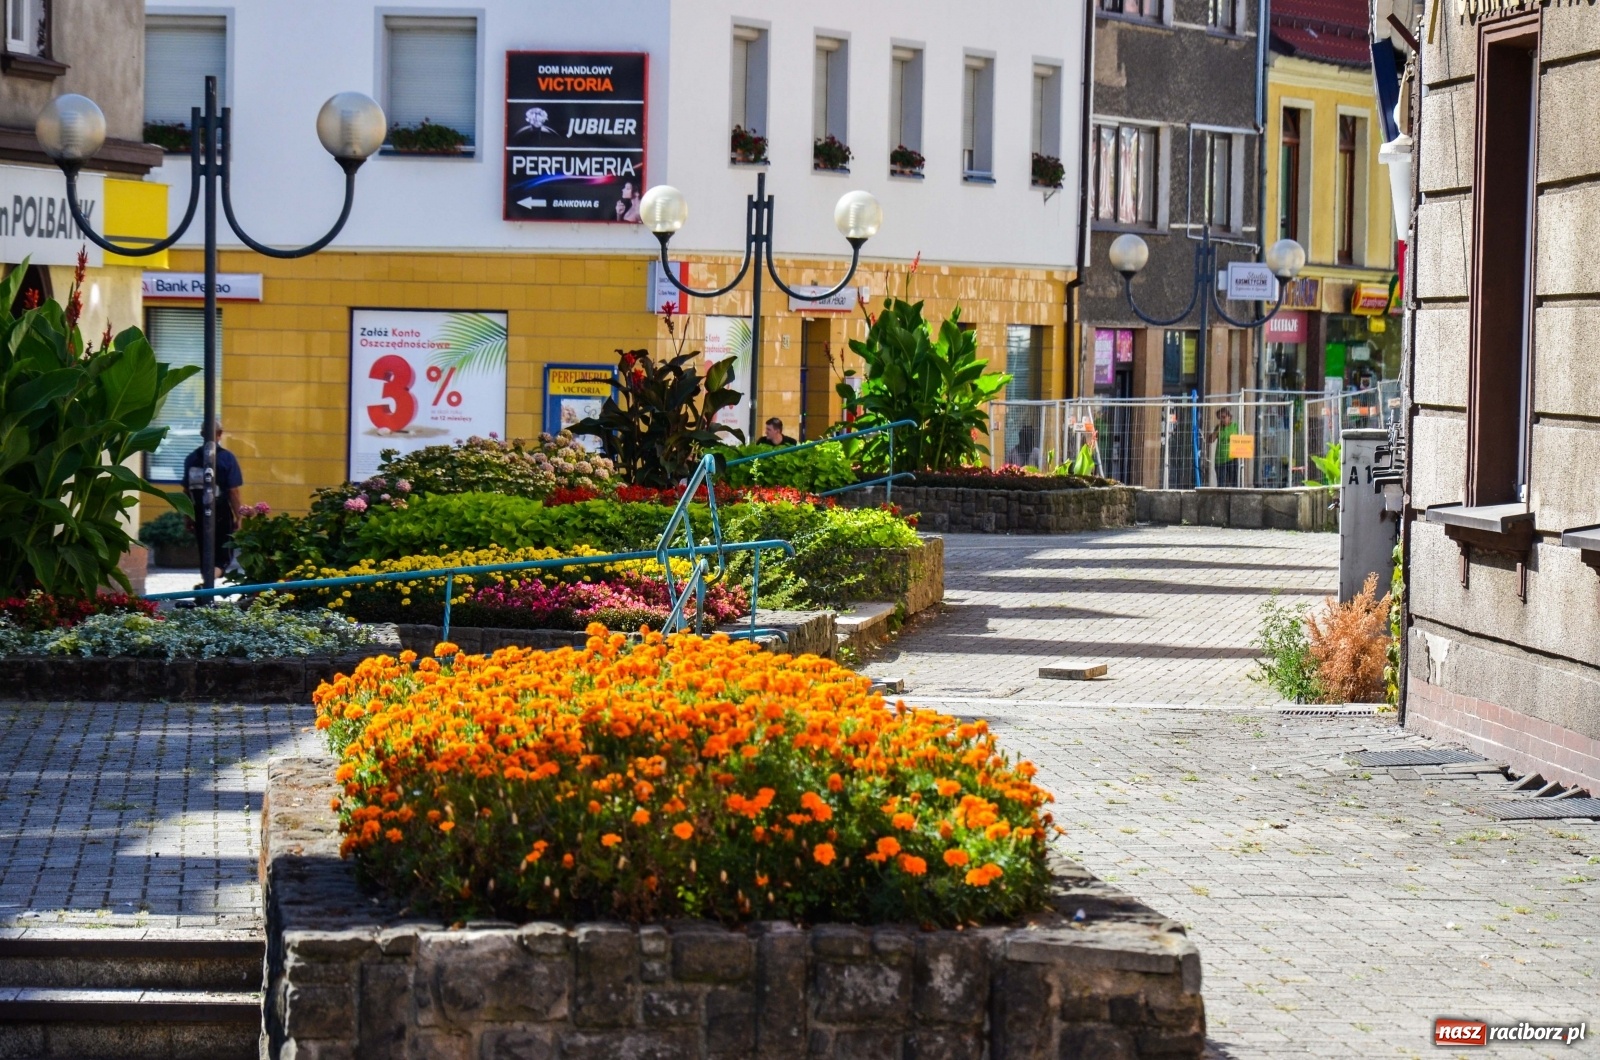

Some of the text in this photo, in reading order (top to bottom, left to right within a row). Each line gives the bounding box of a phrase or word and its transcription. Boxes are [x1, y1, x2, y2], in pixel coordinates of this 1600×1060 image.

[538, 65, 613, 75] DOM HANDLOWY
[538, 77, 613, 92] VICTORIA
[566, 118, 637, 138] JUBILER
[512, 155, 636, 177] PERFUMERIA
[552, 199, 600, 209] BANKOWA 6
[156, 279, 231, 294] Bank Peao
[360, 327, 421, 338] Załóż Konto
[360, 338, 451, 350] Oszczędnościowe
[1349, 466, 1359, 485] A
